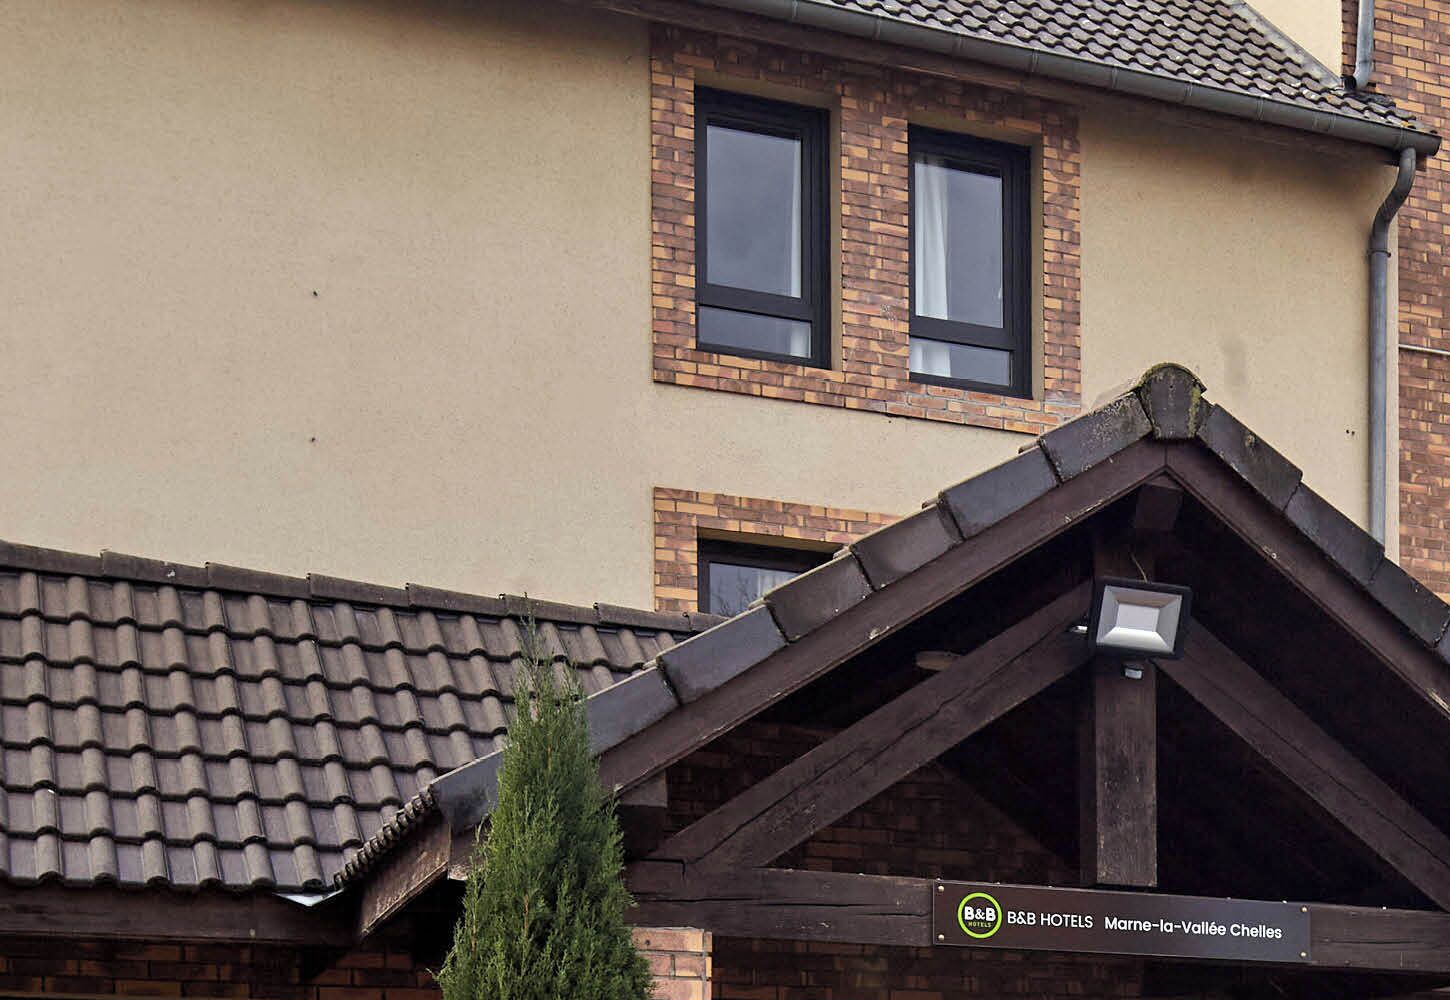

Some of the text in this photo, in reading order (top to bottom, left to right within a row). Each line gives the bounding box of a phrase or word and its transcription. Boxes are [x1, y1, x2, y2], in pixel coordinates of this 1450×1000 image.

[964, 906, 996, 922] B&B
[1007, 911, 1282, 939] B&B HOTELS Marne-la-Vallée Chelles
